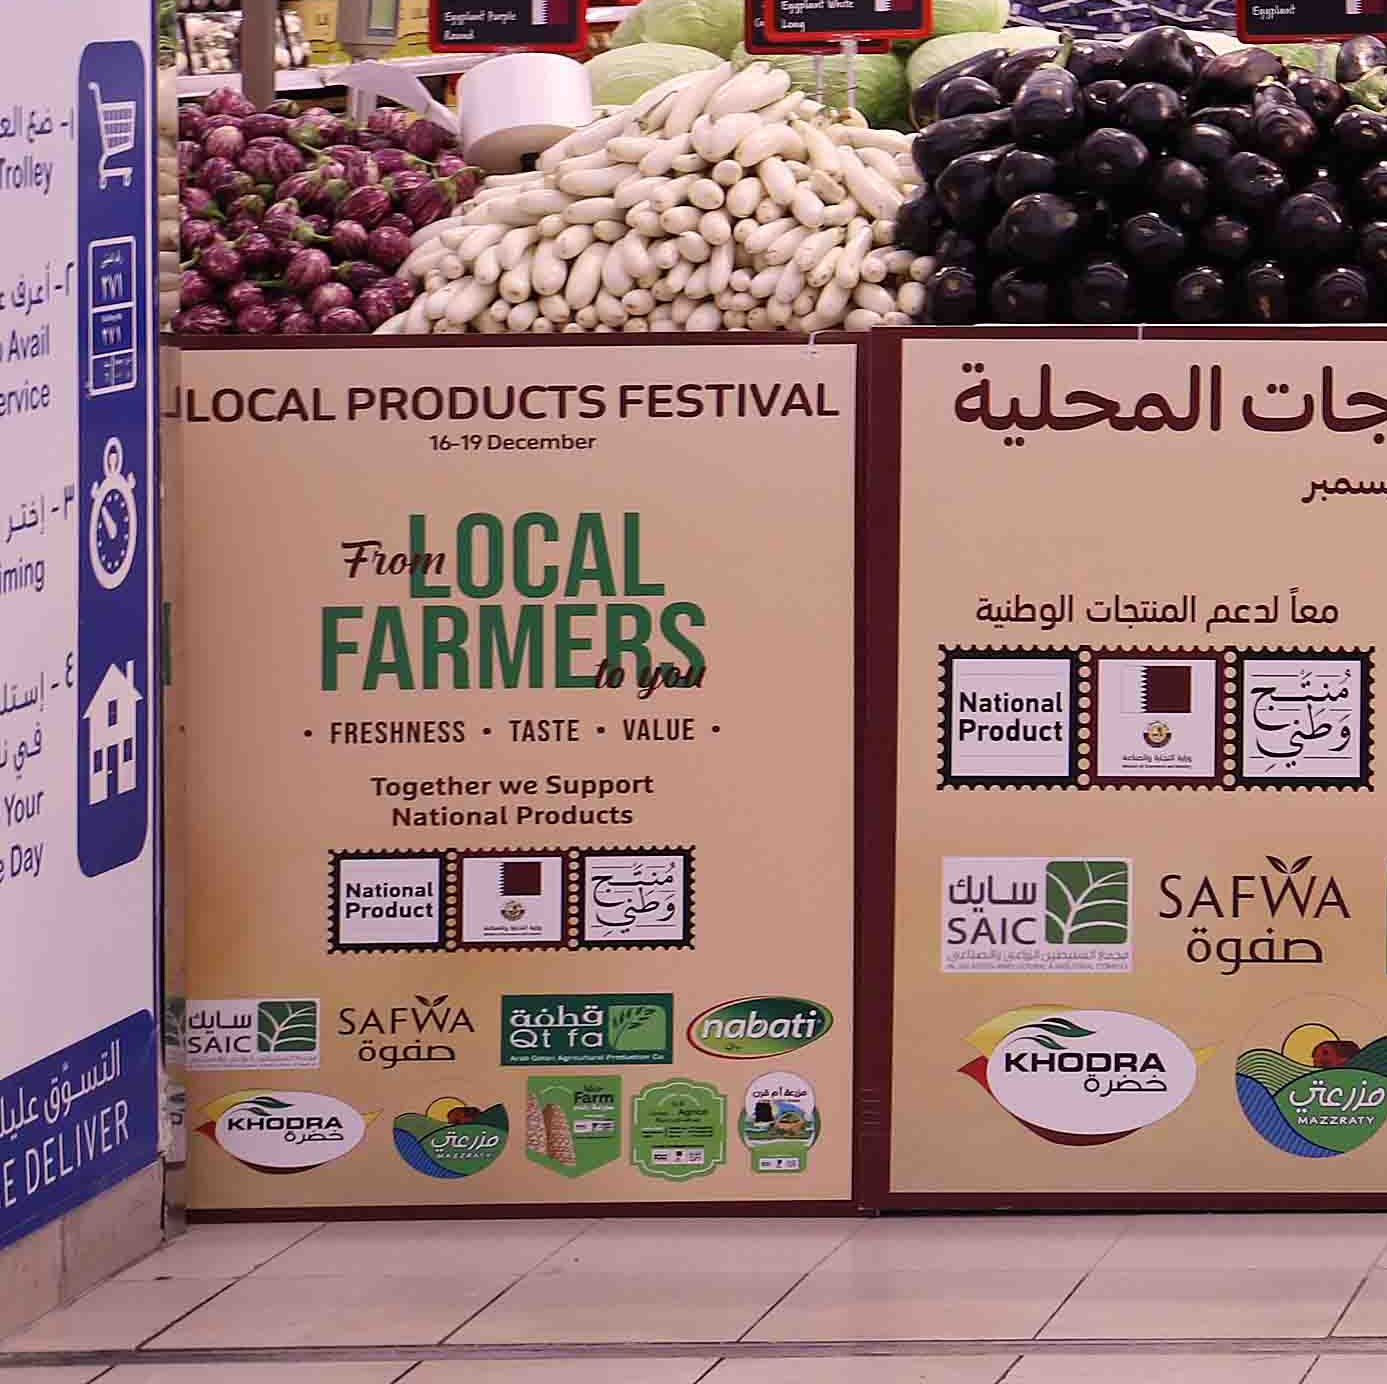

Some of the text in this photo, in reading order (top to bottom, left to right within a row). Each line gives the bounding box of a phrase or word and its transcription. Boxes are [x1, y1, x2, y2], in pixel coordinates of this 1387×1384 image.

[7, 323, 50, 362] Avail
[186, 383, 839, 424] LOCAL PRODUCTS FESTIVAL
[955, 363, 1221, 446] المحلية
[488, 434, 596, 450] December
[409, 511, 665, 600] LOCAL
[976, 595, 1073, 630] الوطنية
[1086, 595, 1195, 629] المنتجات
[1206, 596, 1278, 633] لدعم
[320, 601, 707, 693] FARMERS
[960, 692, 1062, 712] National
[960, 718, 1062, 741] Product
[4, 787, 45, 828] Your
[11, 841, 44, 879] Day
[1159, 873, 1351, 919] SAFWA
[1005, 1053, 1166, 1072] KHODRA
[228, 1117, 343, 1130] KHODRA
[25, 1098, 130, 1195] DELIVER
